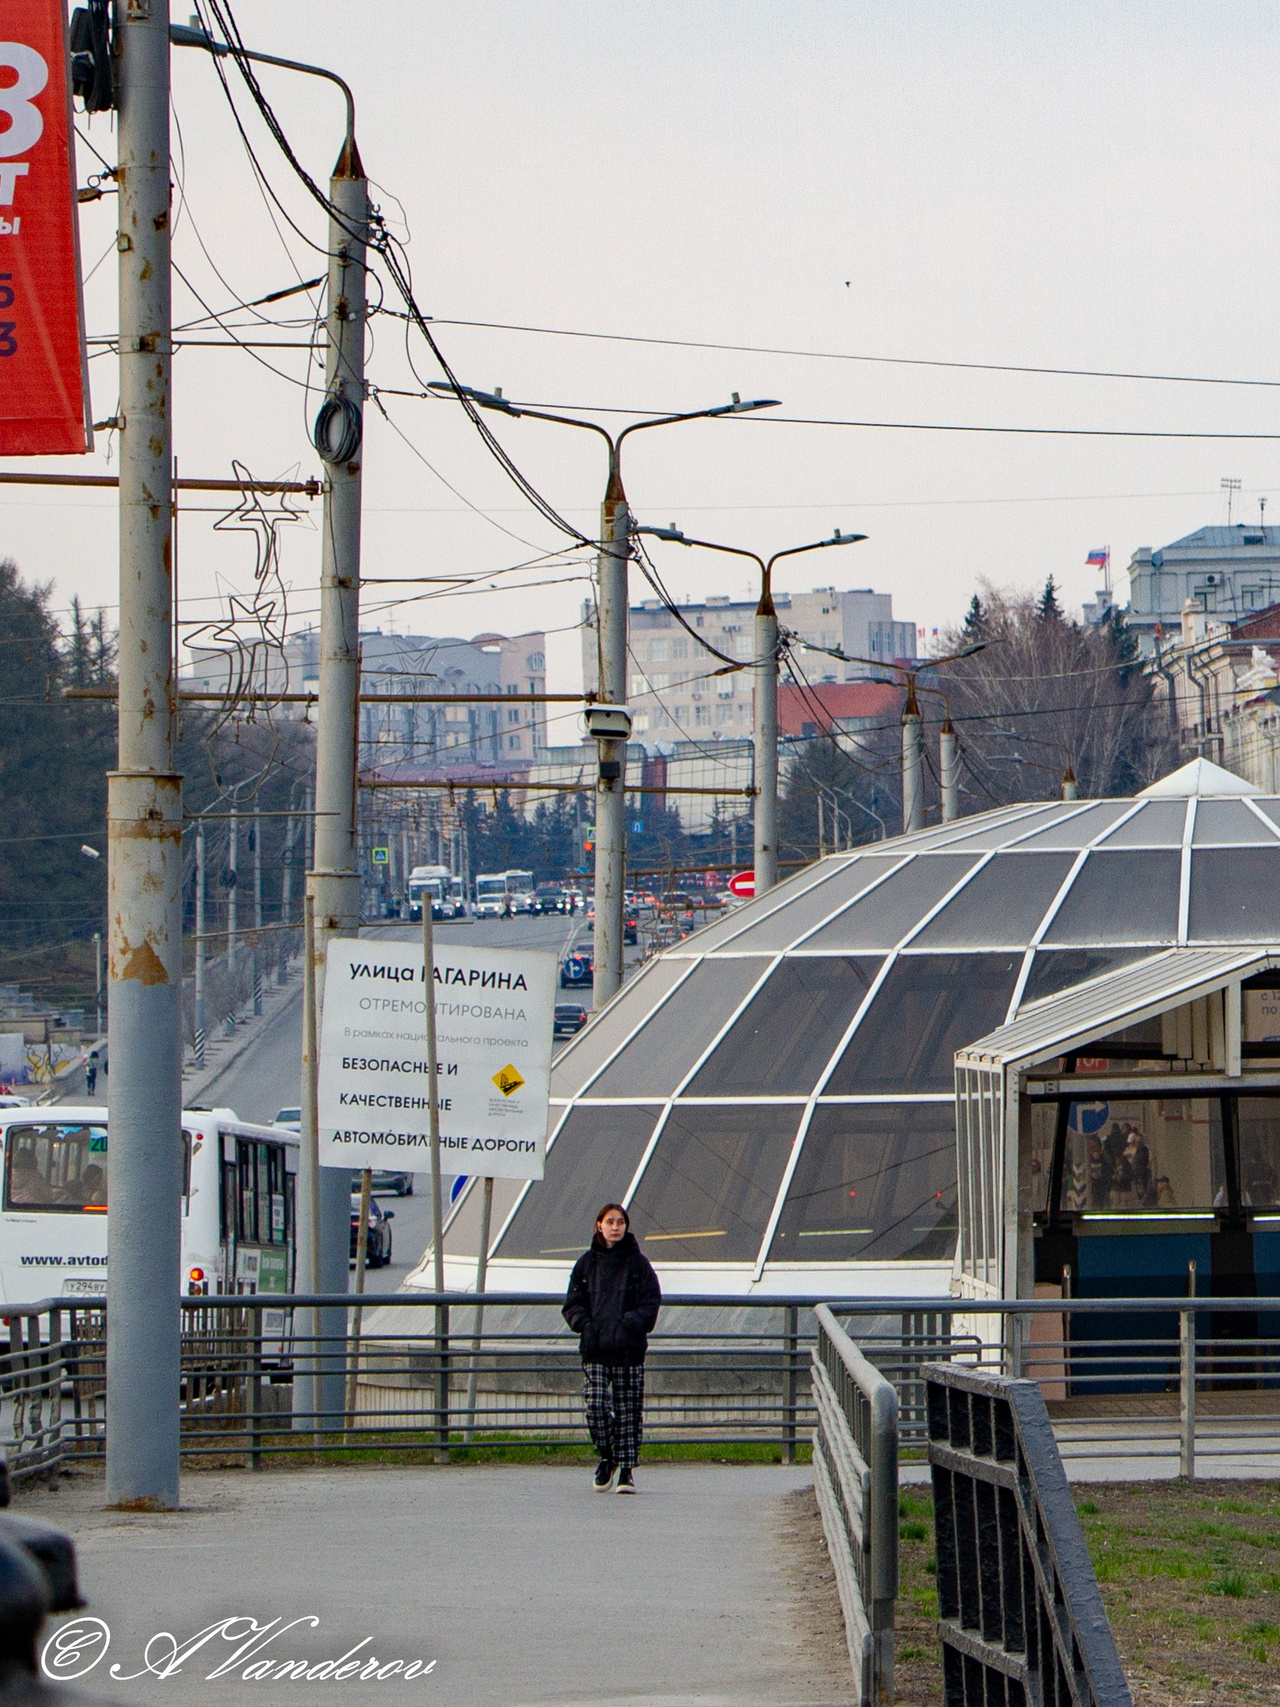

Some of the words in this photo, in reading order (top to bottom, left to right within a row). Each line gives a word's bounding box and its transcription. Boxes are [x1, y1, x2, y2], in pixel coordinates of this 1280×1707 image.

[350, 963, 414, 983] улица
[359, 997, 527, 1021] ОТРЕМОТИРОВАНА
[353, 1029, 394, 1039] рамках
[396, 1032, 480, 1045] нациального
[483, 1037, 529, 1048] проекта
[447, 1063, 458, 1076] И
[332, 1130, 468, 1149] АВТОМОБИЛНЫЕ
[471, 1138, 536, 1152] ДОРОГИ
